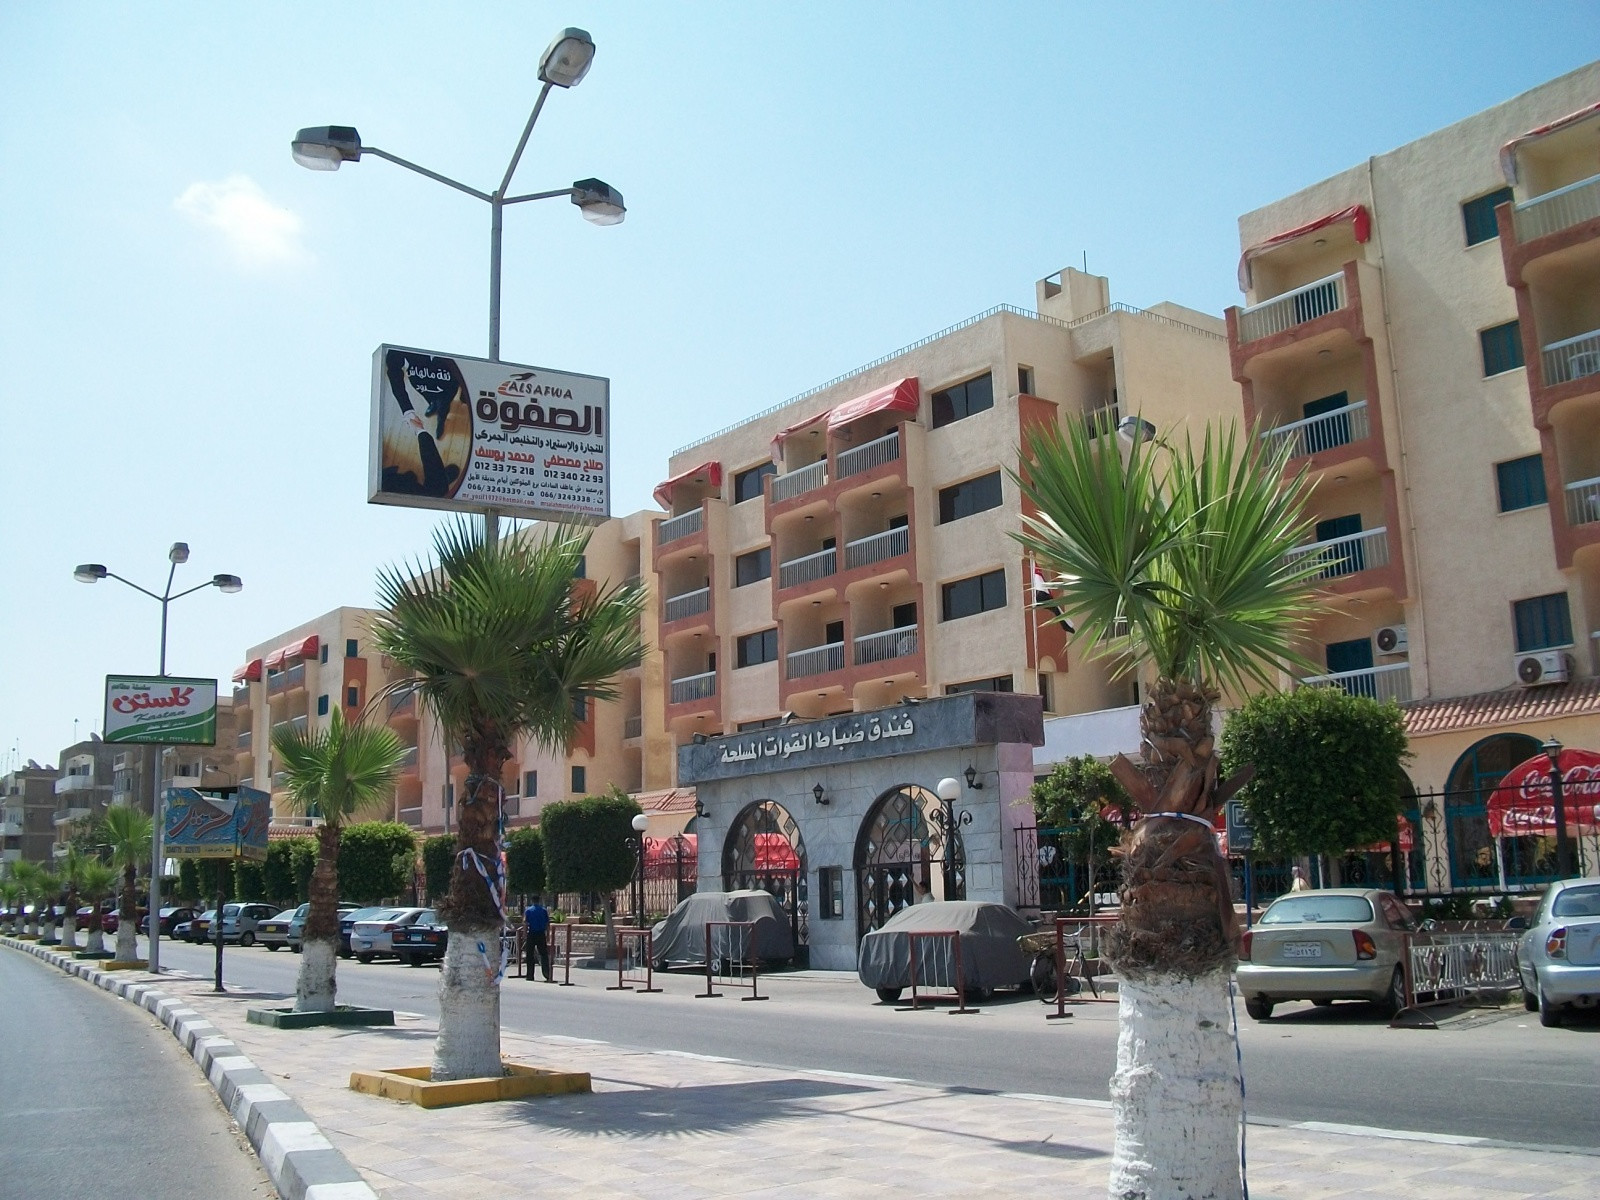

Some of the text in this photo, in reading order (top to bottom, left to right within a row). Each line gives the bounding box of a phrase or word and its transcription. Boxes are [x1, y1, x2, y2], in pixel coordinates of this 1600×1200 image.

[437, 368, 450, 381] ثقة
[416, 384, 443, 393] حدود
[508, 381, 573, 400] ALSAFWA
[476, 391, 602, 436] الصفوة
[510, 434, 543, 448] والتخليص
[475, 446, 535, 463] محمد يوسف
[580, 442, 603, 455] للتجارة
[475, 462, 534, 475] 012 33 75 218
[583, 458, 603, 473] صلاح
[544, 470, 603, 483] 012 340 22 93
[719, 712, 915, 764] فندق ضباط القوات المسلحة
